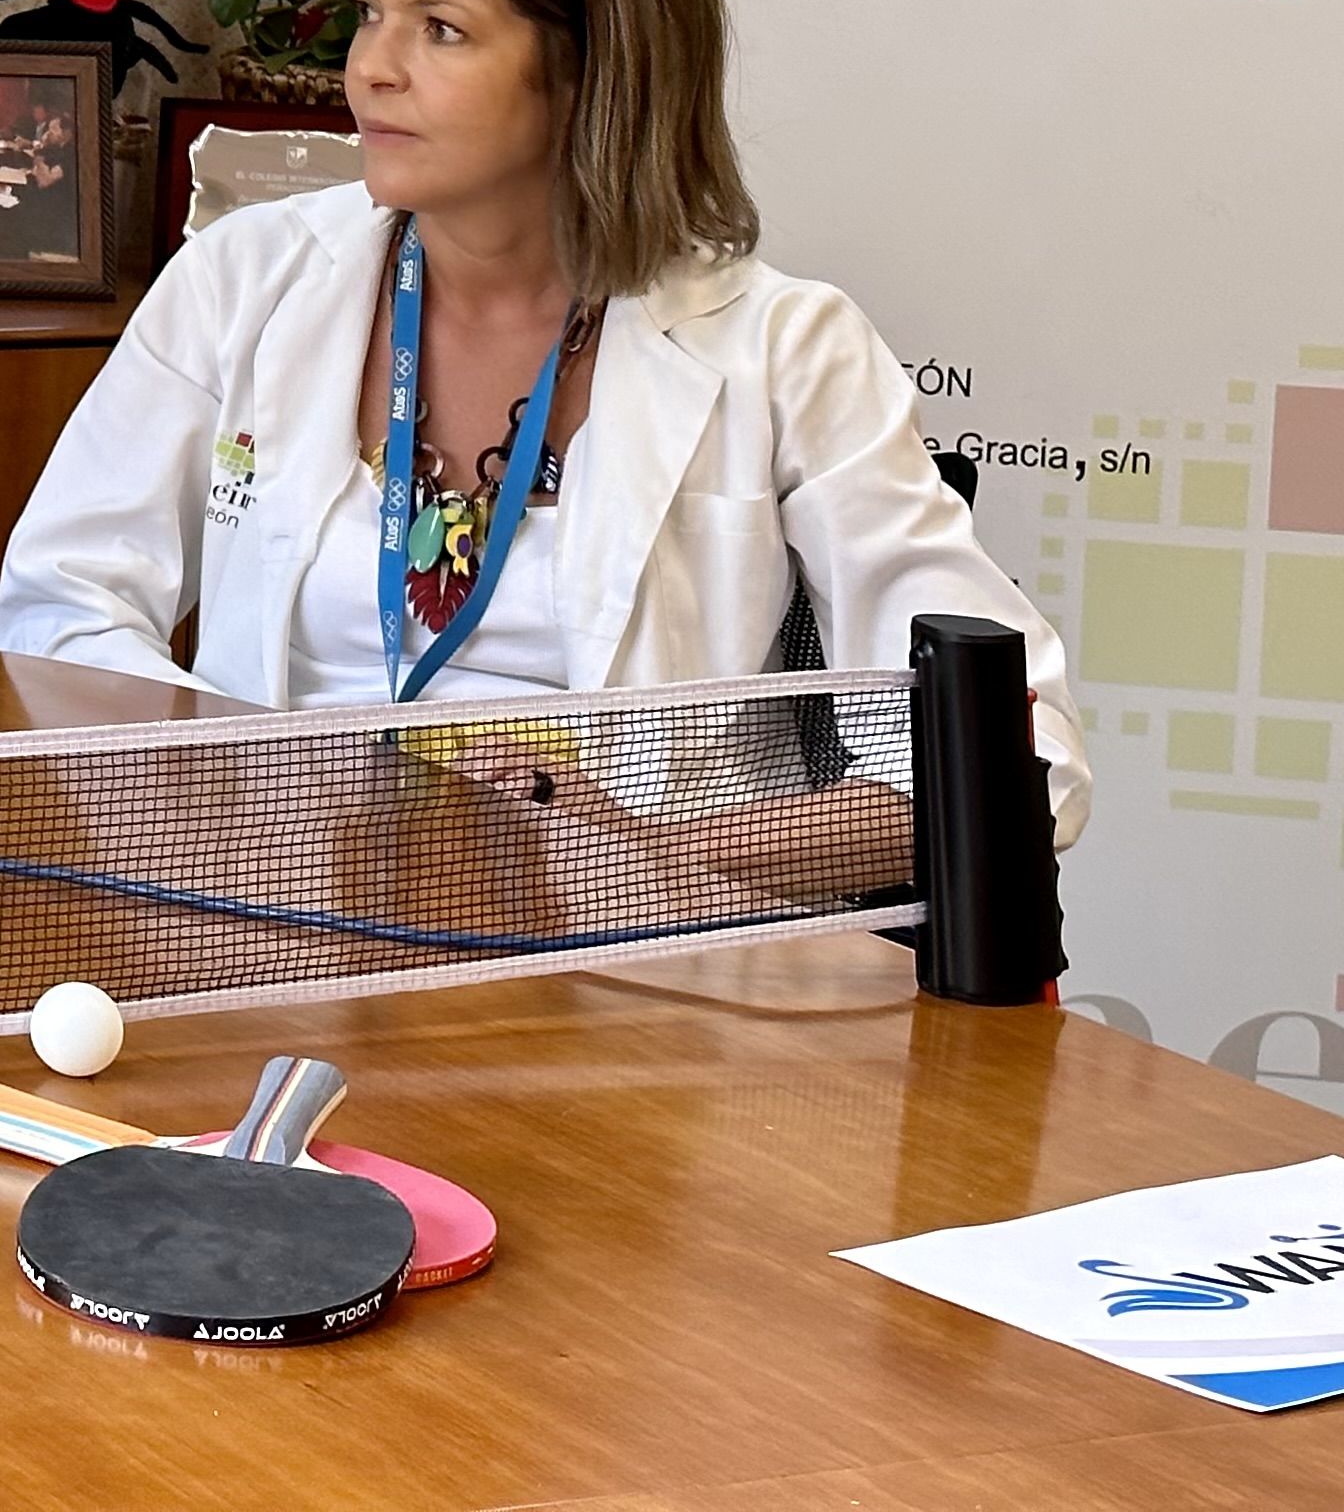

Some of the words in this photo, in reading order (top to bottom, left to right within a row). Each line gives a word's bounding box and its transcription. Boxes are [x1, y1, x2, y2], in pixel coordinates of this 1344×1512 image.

[901, 358, 972, 398] ÓN
[1100, 443, 1151, 475] s/n
[1078, 1245, 1344, 1318] SWA
[211, 1325, 285, 1341] JOOLA
